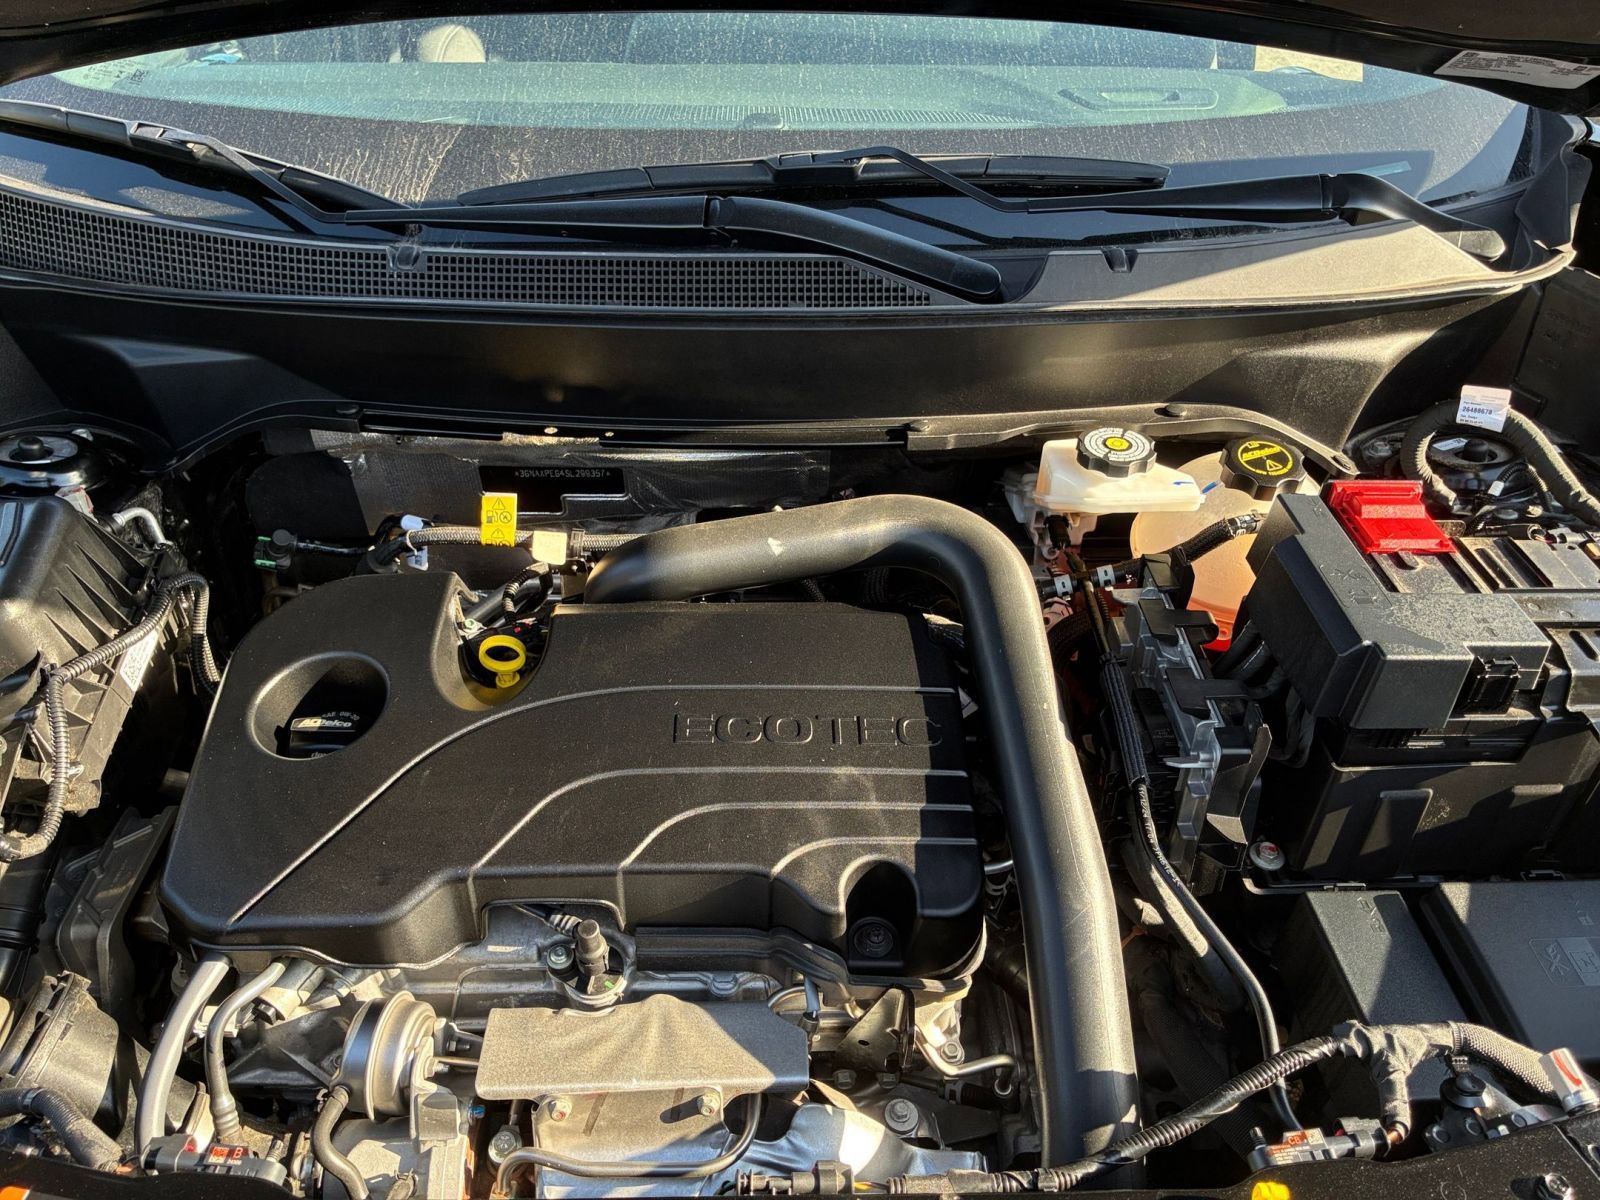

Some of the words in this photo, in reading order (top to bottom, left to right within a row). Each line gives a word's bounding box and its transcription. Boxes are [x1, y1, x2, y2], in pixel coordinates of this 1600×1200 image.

[297, 718, 352, 728] ACDelco
[673, 714, 942, 747] ECOTEC
[233, 1147, 243, 1159] B
